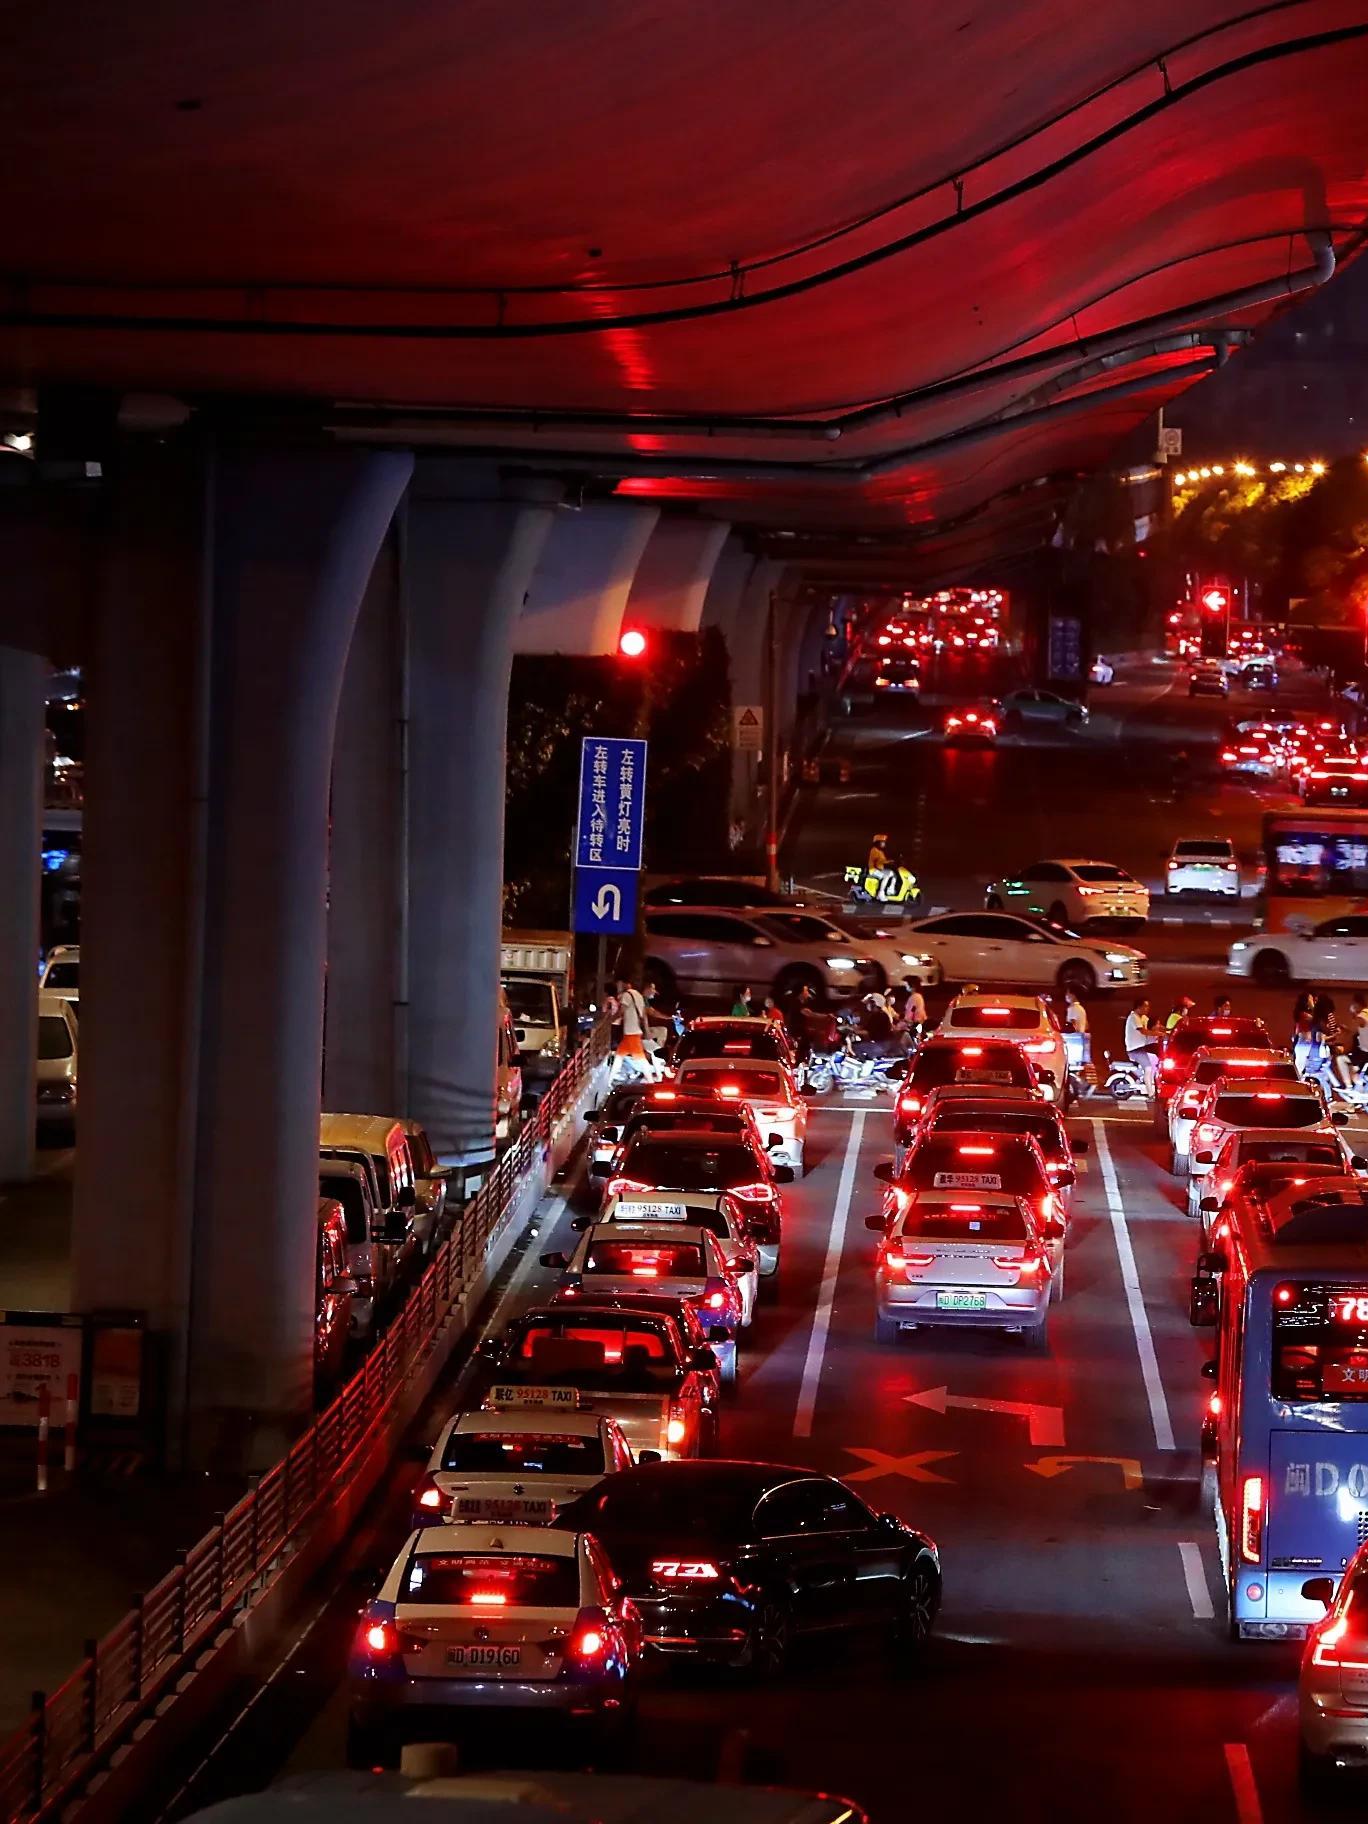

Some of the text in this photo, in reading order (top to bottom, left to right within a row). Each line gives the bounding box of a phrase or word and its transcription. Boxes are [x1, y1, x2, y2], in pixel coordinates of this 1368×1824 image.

[589, 745, 608, 862] 左转车进入待转区
[616, 748, 634, 852] 左转黄灯亮时
[981, 1175, 997, 1184] TAXI
[637, 1204, 662, 1213] 95128
[665, 1206, 681, 1215] TAXI
[516, 1388, 549, 1399] 95128
[552, 1390, 572, 1402] TAXI
[523, 1500, 546, 1514] TAXI
